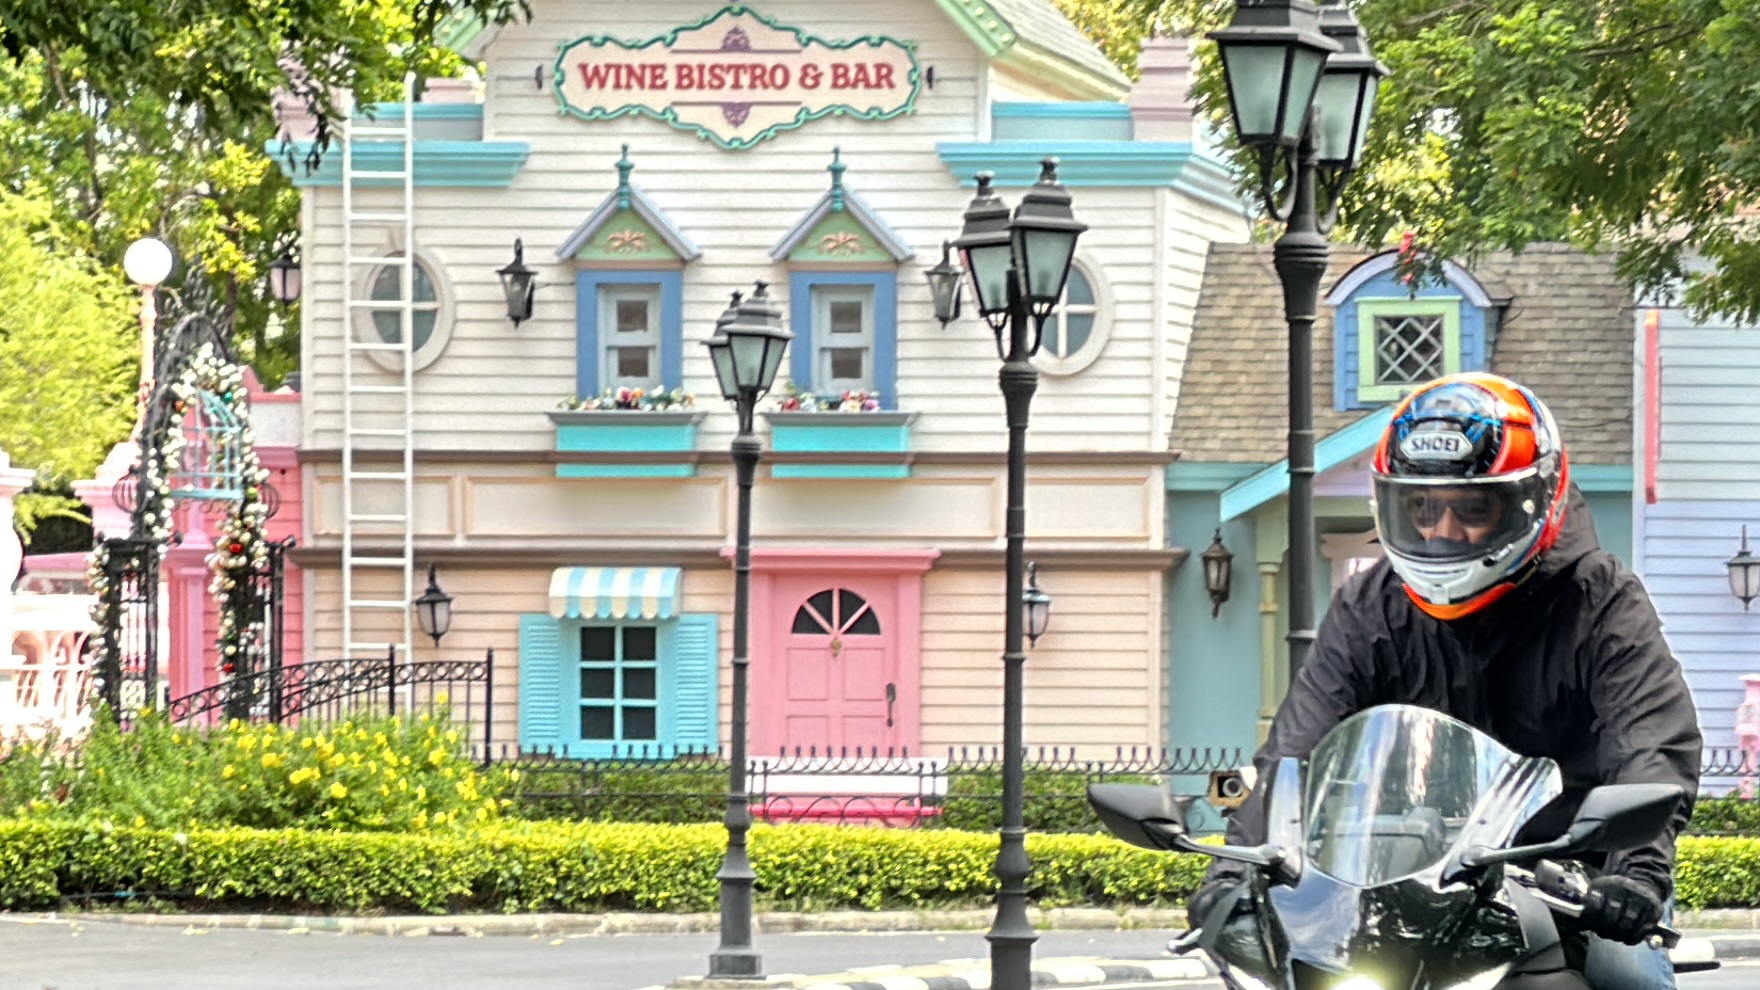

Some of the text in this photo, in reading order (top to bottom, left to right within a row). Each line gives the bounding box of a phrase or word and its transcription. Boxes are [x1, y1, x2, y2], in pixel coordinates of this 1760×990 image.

[578, 63, 896, 90] WINE BISTRO & BAR
[1411, 437, 1459, 452] SHOEI
